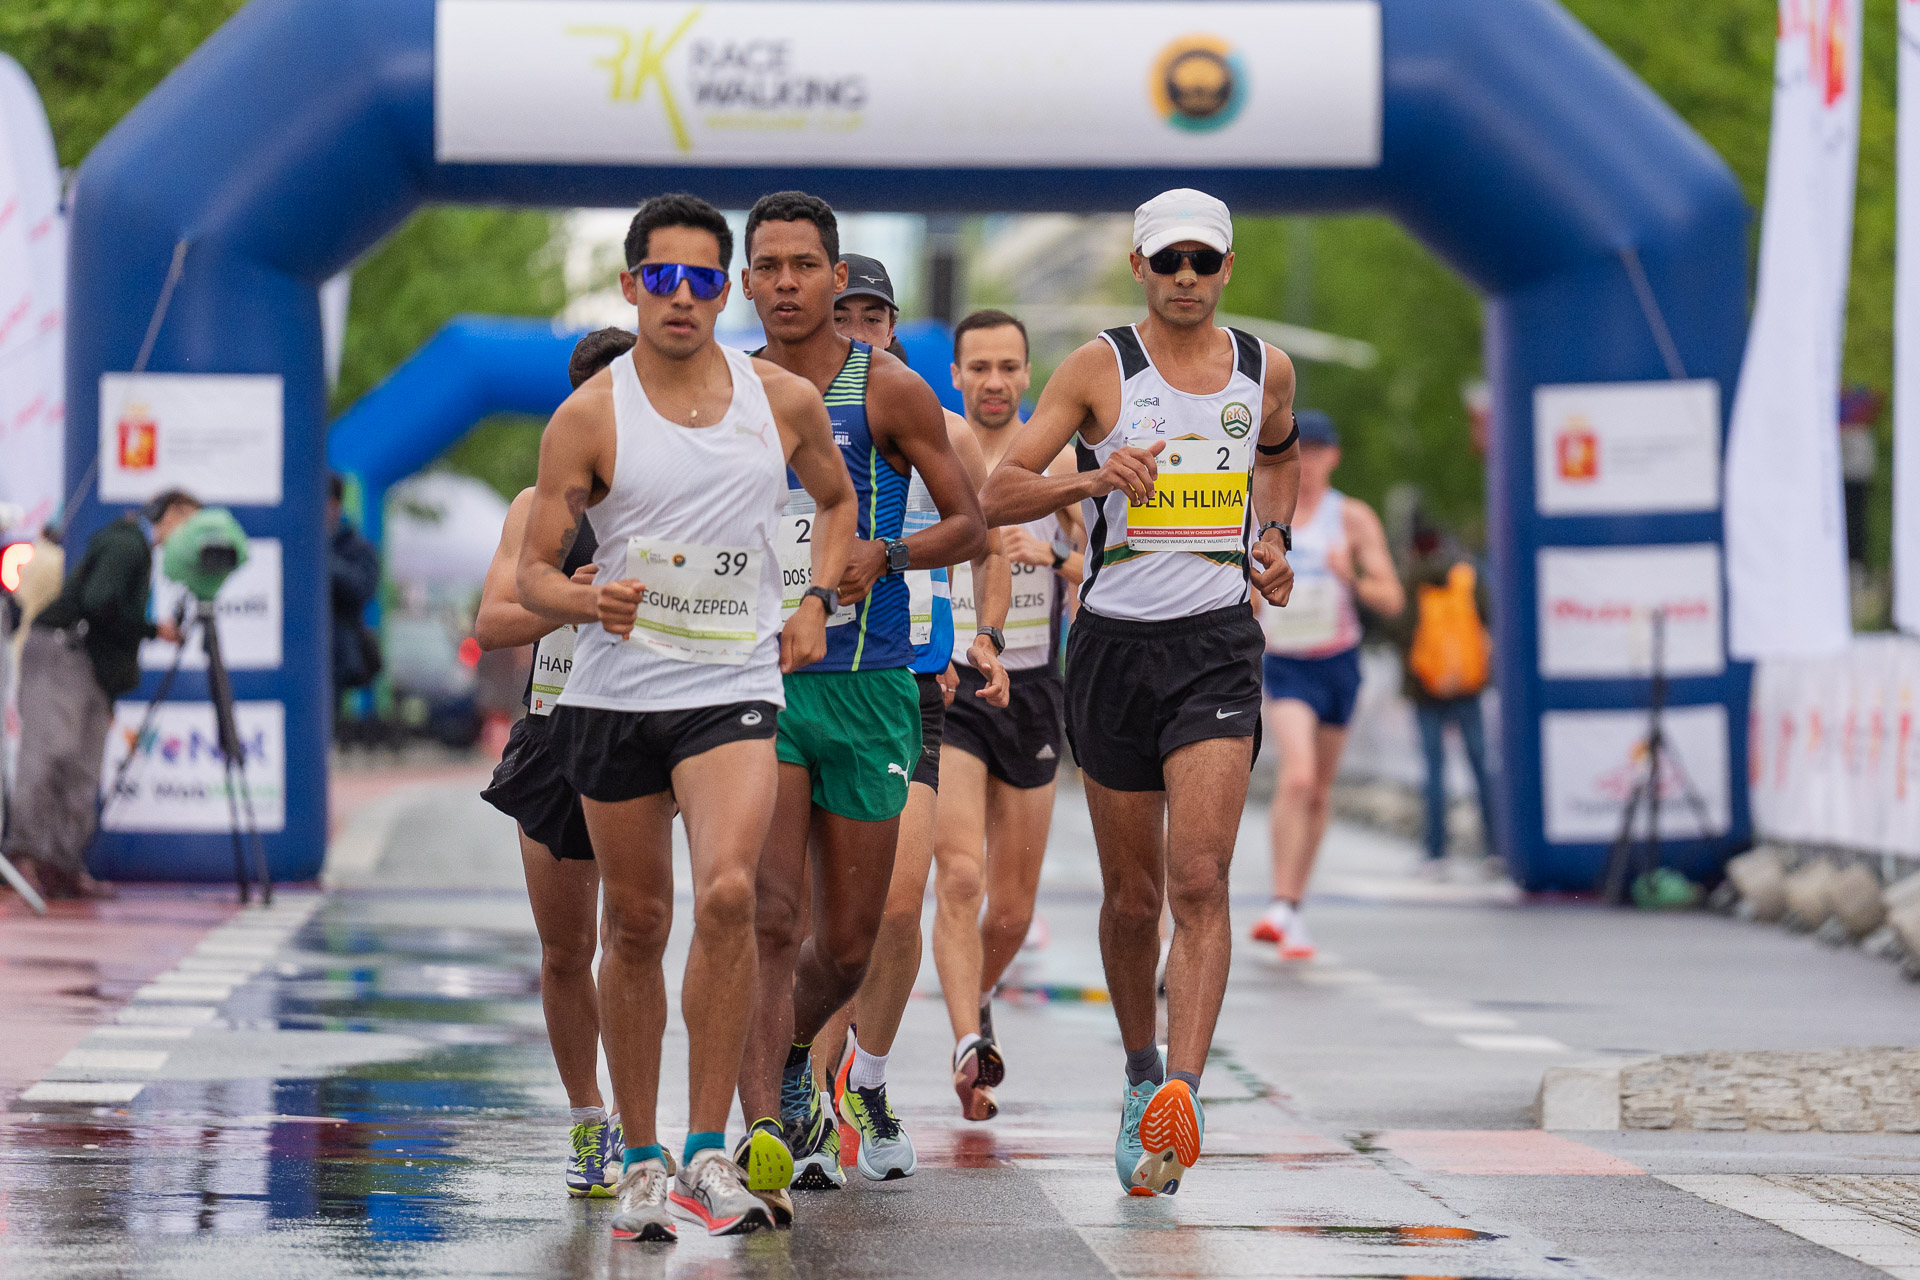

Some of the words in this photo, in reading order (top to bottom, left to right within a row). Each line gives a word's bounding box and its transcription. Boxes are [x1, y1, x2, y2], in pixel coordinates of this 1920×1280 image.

[692, 39, 789, 67] RACE
[695, 74, 867, 109] WALKING
[1226, 407, 1248, 422] RKS
[1216, 446, 1230, 471] 2
[1130, 490, 1175, 508] EN
[1183, 490, 1244, 508] HLIMA
[714, 551, 748, 576] 39
[783, 568, 806, 586] DOS
[641, 588, 690, 614] EGURA
[693, 599, 749, 616] ZEPEDA
[539, 654, 573, 674] HAR
